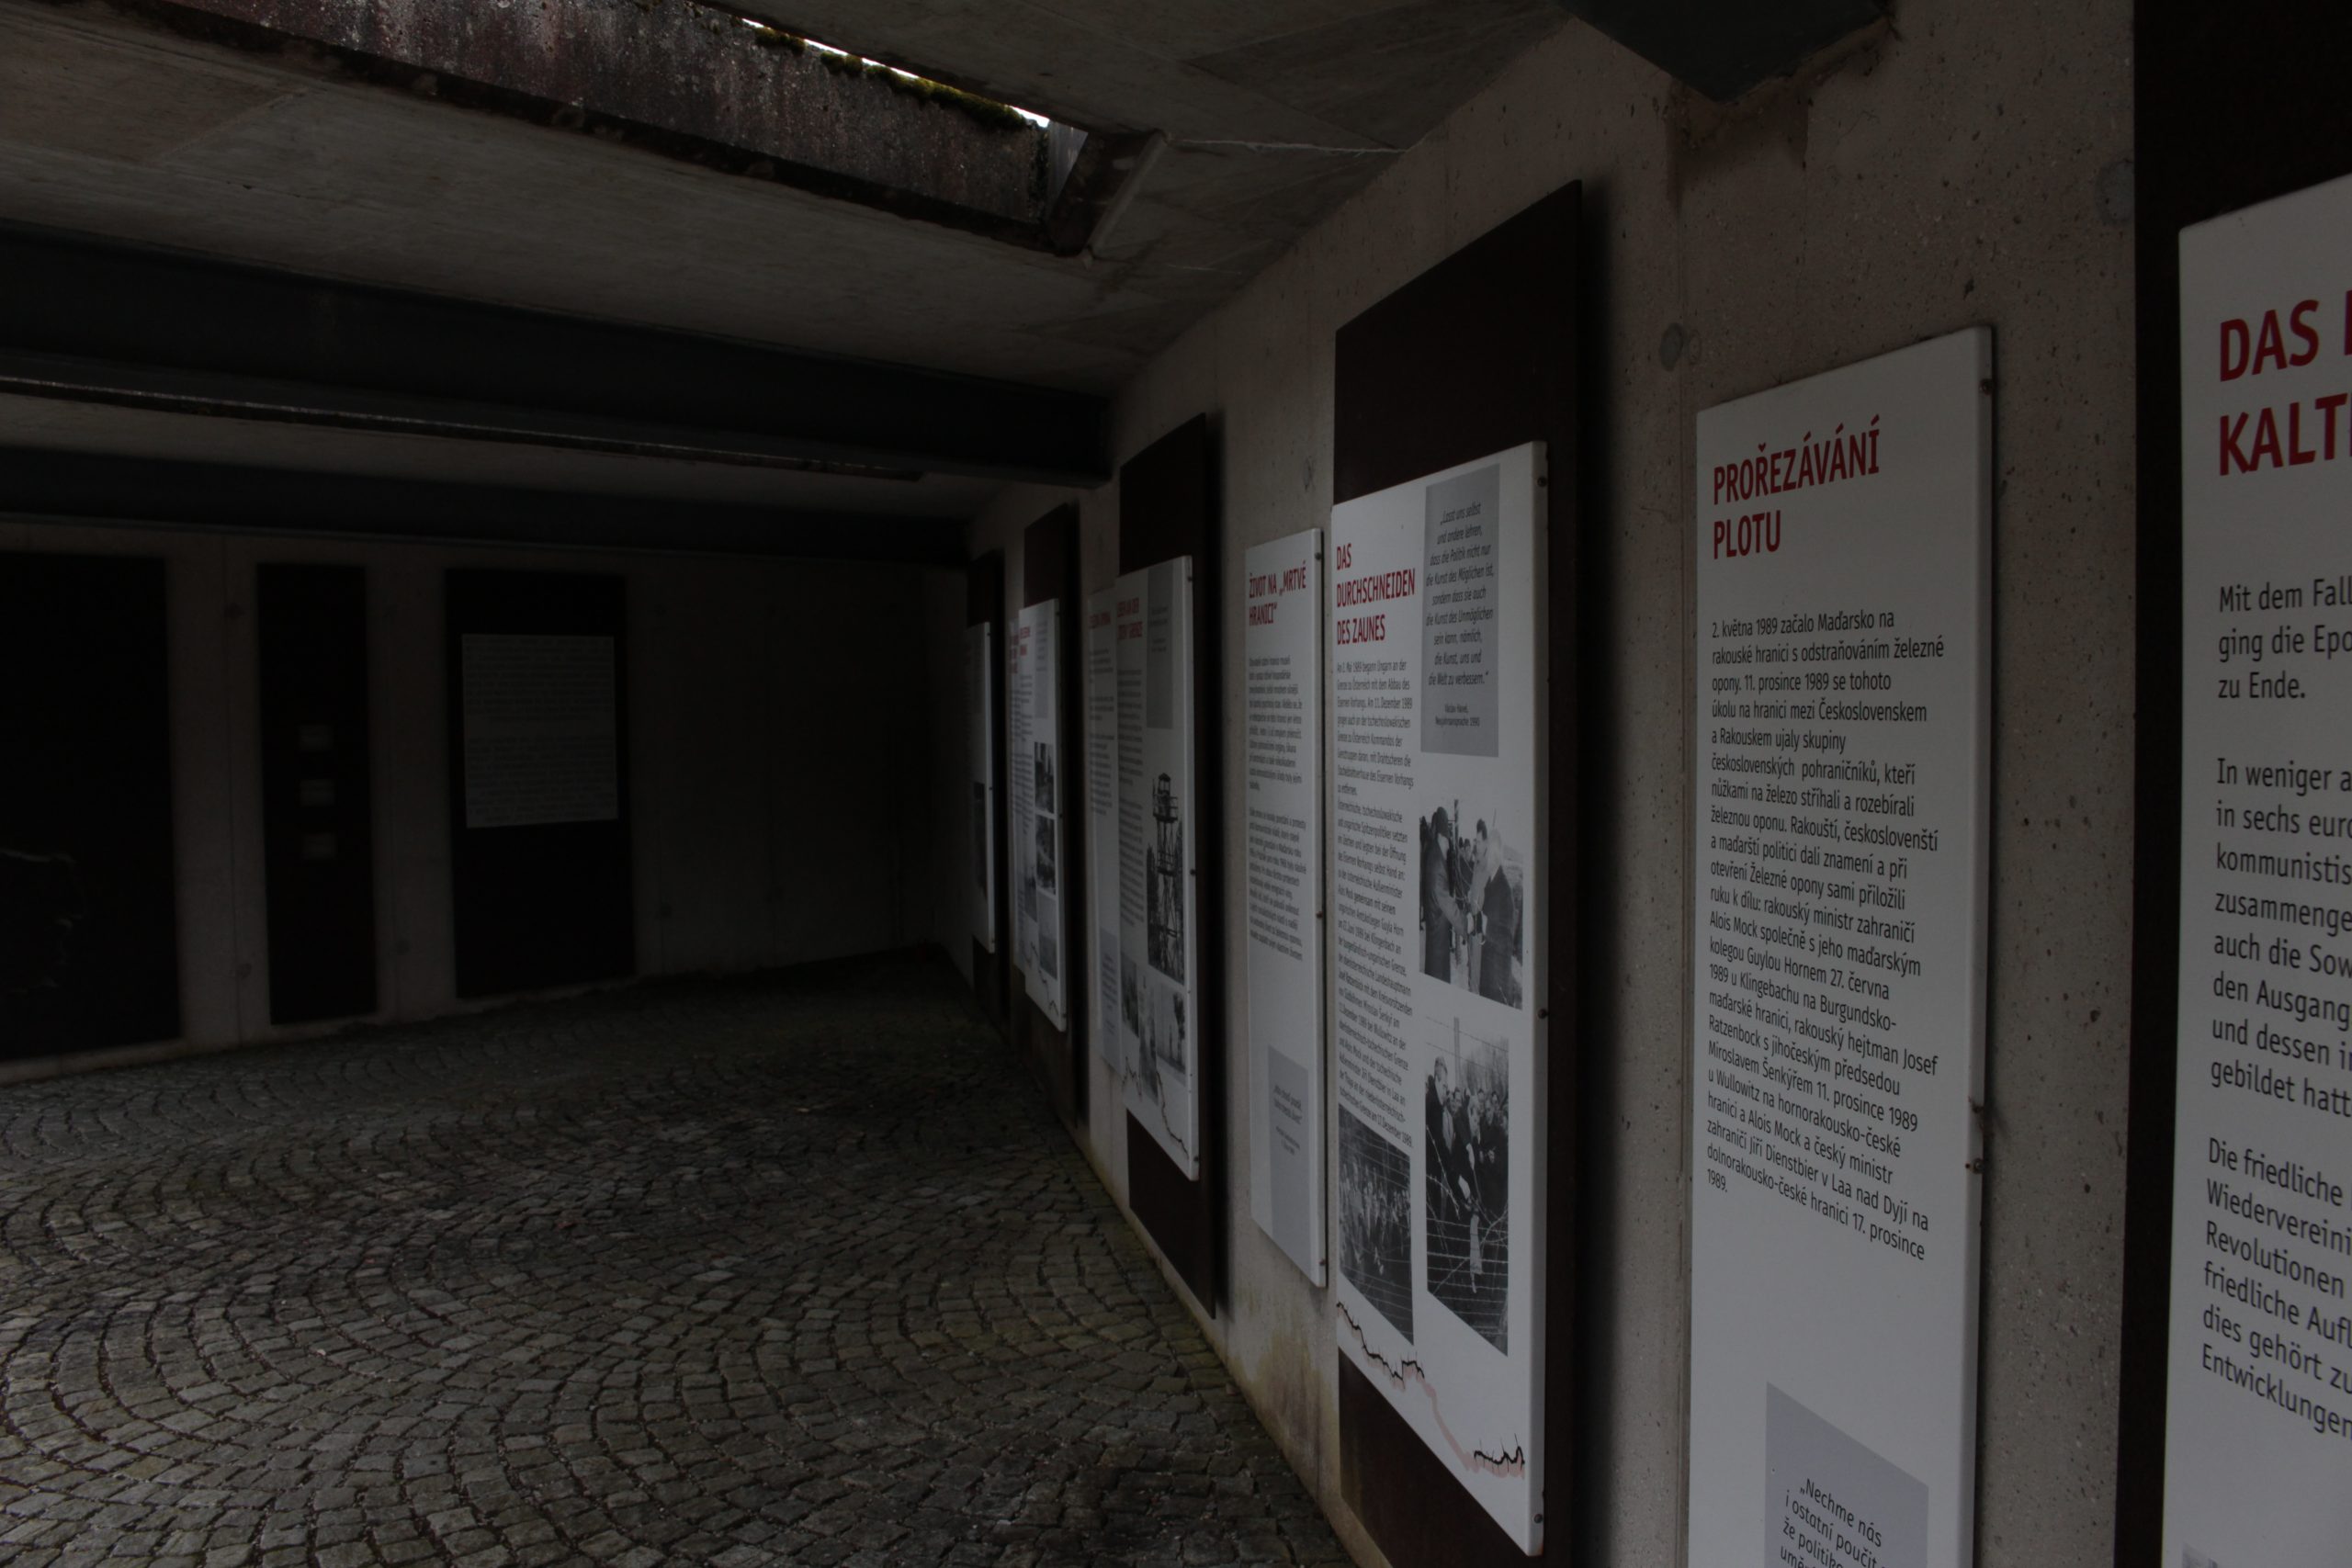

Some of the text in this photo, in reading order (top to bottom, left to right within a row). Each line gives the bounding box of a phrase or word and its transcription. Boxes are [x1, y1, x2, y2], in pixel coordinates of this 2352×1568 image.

[2220, 299, 2319, 381] DAS
[2220, 393, 2352, 475] KALT
[1714, 415, 1879, 504] PROŘEZÁVÁNÍ
[1337, 543, 1351, 570] DAS
[1713, 510, 1781, 559] PLOTU
[1249, 572, 1266, 599] ŽIVOT
[1268, 573, 1277, 594] NA
[1337, 568, 1416, 607] DURCHSCHNEIDEN
[2220, 576, 2352, 612] Mit dem Fall
[1337, 614, 1385, 645] DES ZAUNES
[1713, 610, 1894, 637] 2. května 1989 začalo Maďarsko na
[2219, 628, 2262, 661] ging
[2272, 626, 2304, 653] die
[1713, 635, 1944, 664] rakouské hranici s odstraňováním železné
[1713, 671, 1891, 694] opony. 11. prosince 1989 se tohoto
[2218, 671, 2305, 697] zu Ende.
[1713, 697, 1927, 721] úkolu na hranici mezi Československem
[1712, 728, 1846, 754] a Rakouskem ujaly skupiny
[1712, 752, 1915, 785] československých pohraničníků, kteří
[2217, 758, 2237, 784] In
[2245, 761, 2332, 795] weniger
[1711, 805, 1938, 851] železnou oponu. Rakouští, českoslovenští
[2216, 800, 2234, 827] in
[2244, 805, 2300, 832] sechs
[1711, 886, 1729, 904] ruku
[1734, 889, 1737, 906] k
[1741, 890, 1760, 910] dílu:
[1764, 897, 1810, 925] rakouský
[1814, 906, 1853, 930] ministr
[1710, 911, 1920, 977] Alois Mock společně s jeho maďarským
[2214, 933, 2259, 960] auch
[2268, 938, 2301, 968] die
[1711, 936, 1744, 962] kolegou
[1785, 956, 1826, 984] Hornem
[1830, 968, 1844, 987] 27.
[1849, 971, 1889, 999] června
[2213, 971, 2247, 1001] den
[1710, 964, 1728, 982] 1989
[1732, 973, 1736, 986] u
[1804, 994, 1815, 1010] na
[1820, 995, 1896, 1031] Burgundsko-
[1756, 1002, 1791, 1033] hranici,
[1795, 1018, 1844, 1051] rakouský
[1849, 1031, 1898, 1064] hejtman
[1903, 1049, 1939, 1075] Josef
[2213, 1020, 2247, 1044] und
[2256, 1023, 2329, 1065] dessen
[2211, 1060, 2295, 1101] gebildet
[1709, 1069, 1900, 1157] u Wullowitz na hornorakousko-české
[1708, 1090, 1893, 1184] hranici a Alois Mock a český ministr
[1707, 1168, 1727, 1192] 1989.
[1749, 1136, 1762, 1156] Jiří
[1766, 1144, 1818, 1181] Dienstbier
[1822, 1172, 1827, 1186] v
[1832, 1173, 1851, 1198] Laa
[1857, 1188, 1878, 1209] nad
[1884, 1195, 1907, 1224] Dyjí
[1913, 1212, 1928, 1231] na
[2210, 1138, 2343, 1206] Die friedliche
[1811, 1191, 1848, 1225] hranici
[1852, 1213, 1865, 1233] 17.
[1871, 1224, 1924, 1259] prosince
[2207, 1221, 2344, 1298] Revolutionen
[2204, 1261, 2299, 1325] friedliche
[2203, 1304, 2241, 1341] dies
[2250, 1332, 2322, 1380] gehört
[1785, 1489, 1790, 1507] i
[1792, 1500, 1834, 1540] ostatní
[1858, 1522, 1882, 1547] nás
[1782, 1517, 1795, 1540] že
[1798, 1533, 1844, 1568] politik
